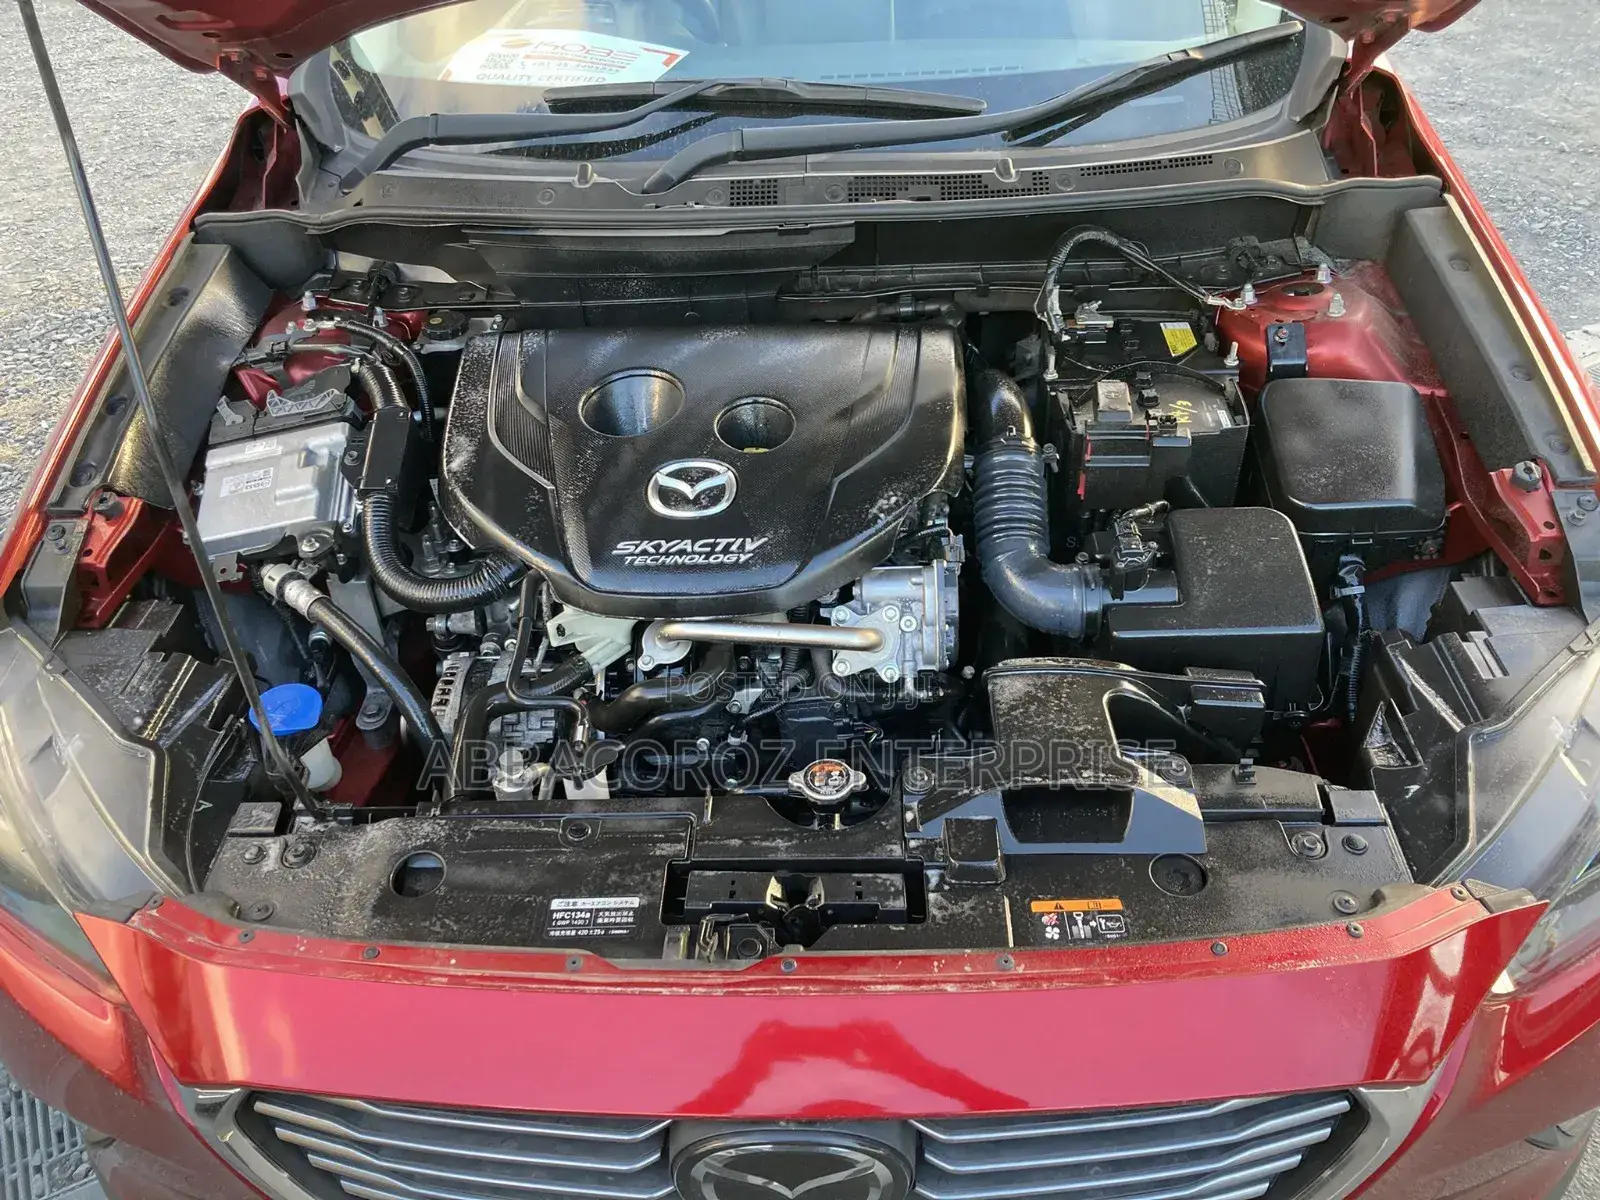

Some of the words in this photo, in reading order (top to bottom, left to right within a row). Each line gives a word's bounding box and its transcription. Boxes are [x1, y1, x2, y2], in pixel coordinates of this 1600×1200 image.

[476, 72, 532, 81] QUALITY
[538, 74, 606, 83] CERTIFIED
[612, 537, 769, 555] SKYACTIV
[623, 553, 754, 566] TECHNOLOGY
[552, 911, 591, 920] HFC134a
